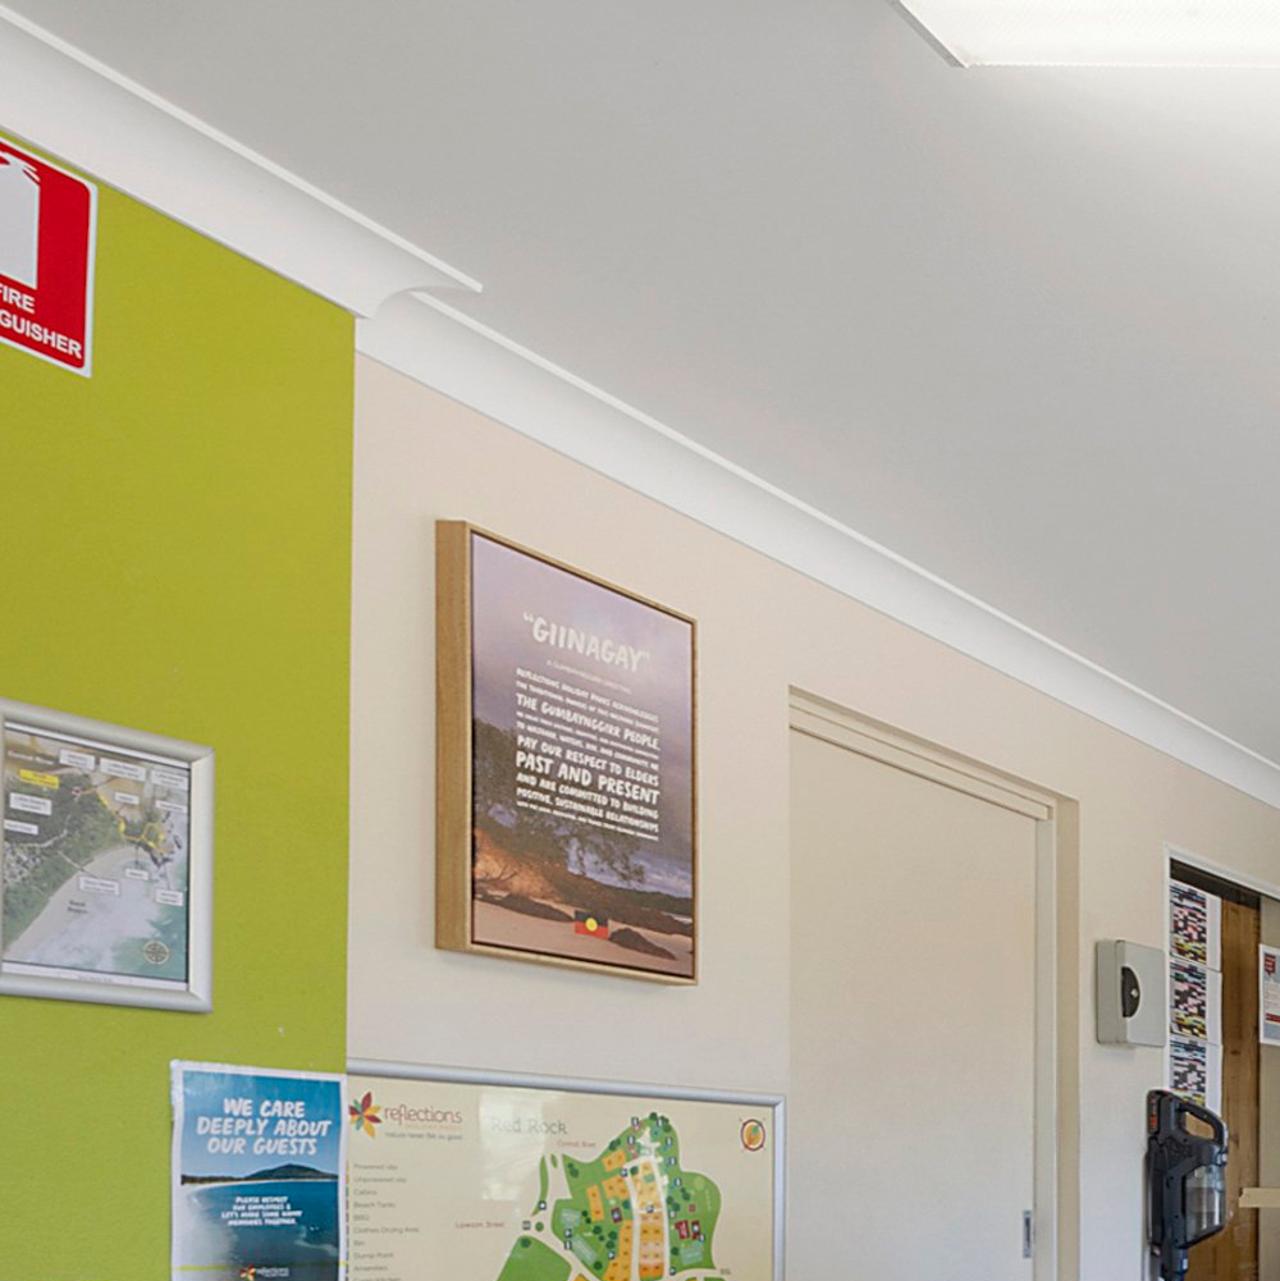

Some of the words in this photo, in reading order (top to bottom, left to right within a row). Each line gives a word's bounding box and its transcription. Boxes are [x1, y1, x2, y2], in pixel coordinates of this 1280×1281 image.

[516, 692, 538, 711] THE
[517, 734, 538, 750] PAY
[540, 742, 562, 758] OUR
[565, 749, 608, 771] RESPECT
[609, 761, 622, 775] TO
[625, 766, 659, 786] ELDERS
[516, 750, 555, 774] PAST
[558, 763, 592, 787] AND
[598, 774, 660, 805] PRESENT
[516, 772, 537, 786] AND
[539, 778, 557, 792] ARE
[610, 797, 621, 809] TO
[224, 1097, 252, 1117] WE
[259, 1100, 305, 1118] CARE
[384, 1103, 463, 1125] reflections
[196, 1117, 268, 1136] DEEPLY
[274, 1120, 331, 1137] ABOUT
[529, 1119, 568, 1135] Rock
[207, 1137, 248, 1154] OUR
[253, 1138, 318, 1156] GUESTS
